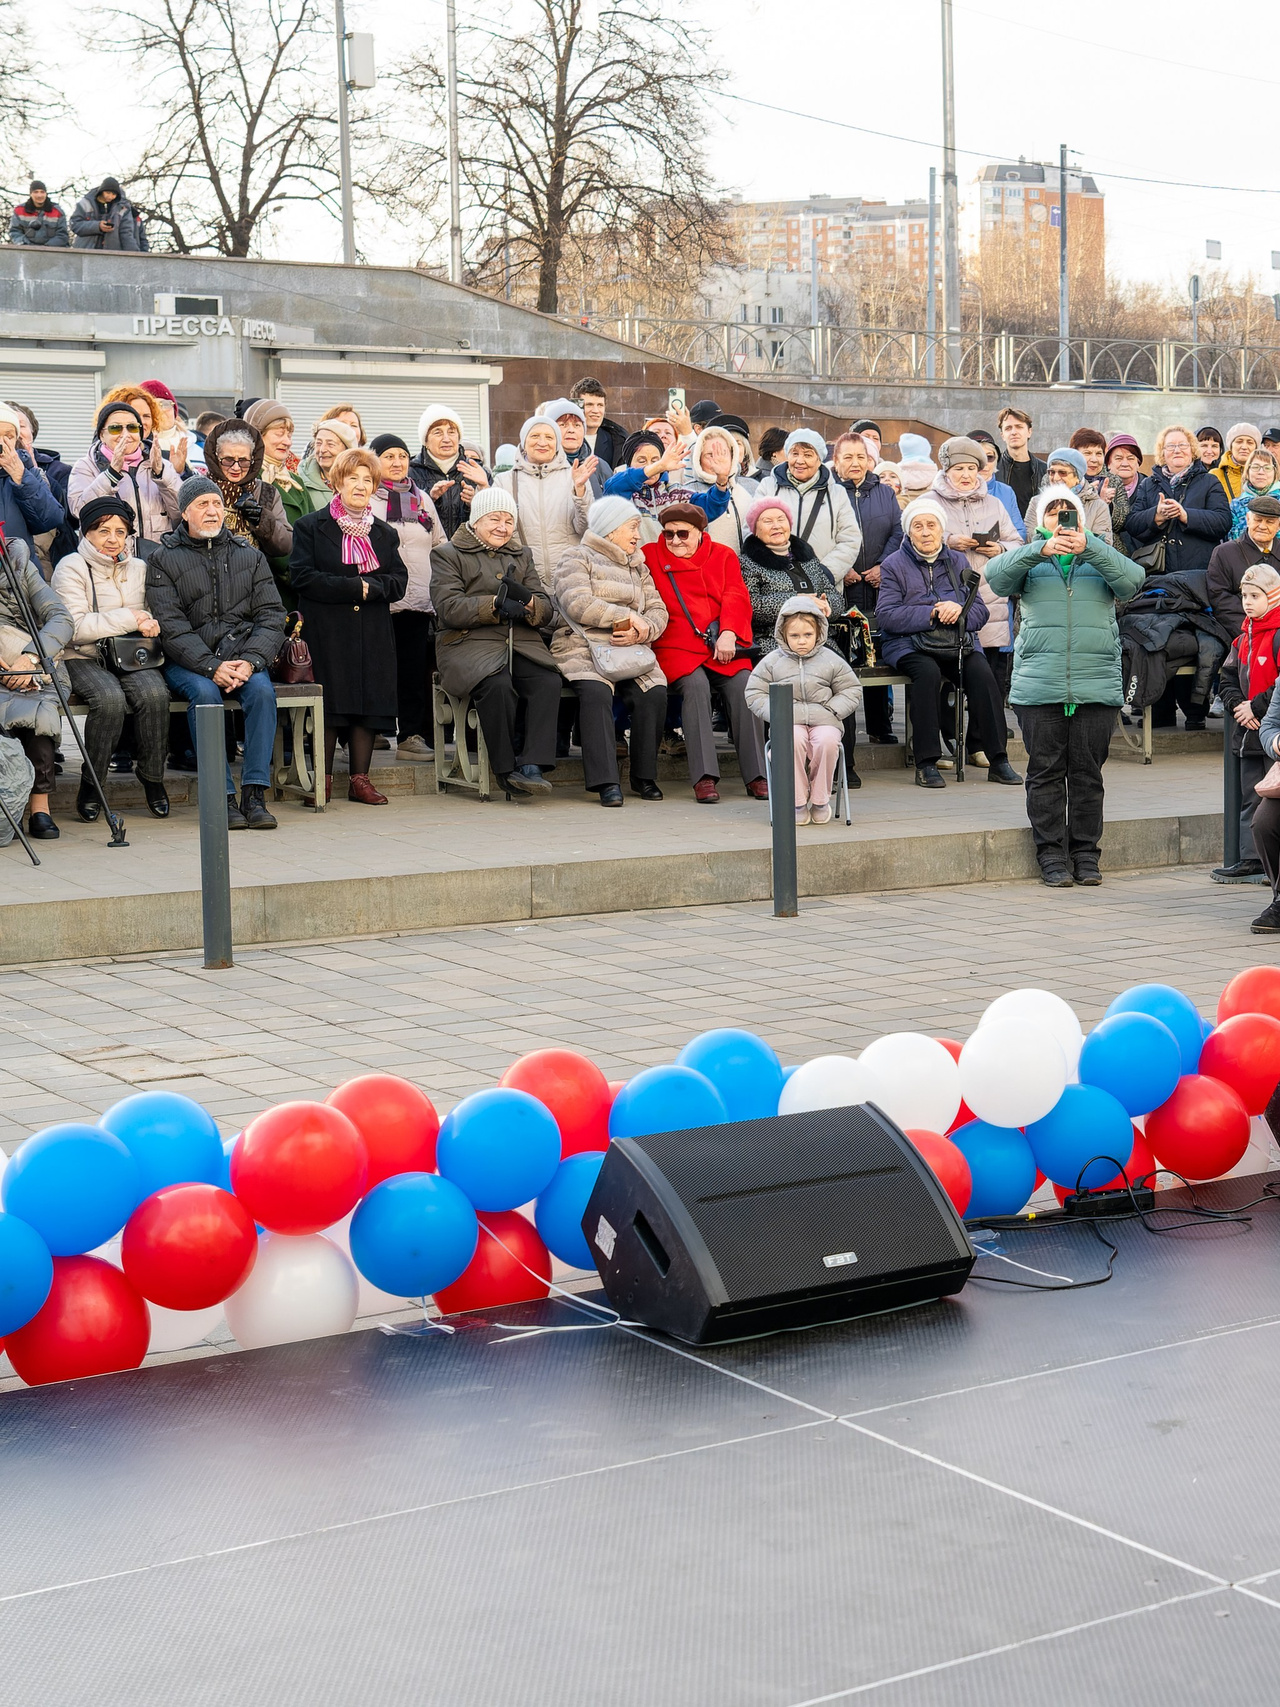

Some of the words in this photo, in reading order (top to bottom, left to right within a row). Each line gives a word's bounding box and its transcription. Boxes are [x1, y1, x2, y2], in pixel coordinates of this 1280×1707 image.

[133, 316, 236, 336] ПРЕССА
[242, 317, 277, 341] ПРЕССА
[826, 1254, 853, 1266] FBT
